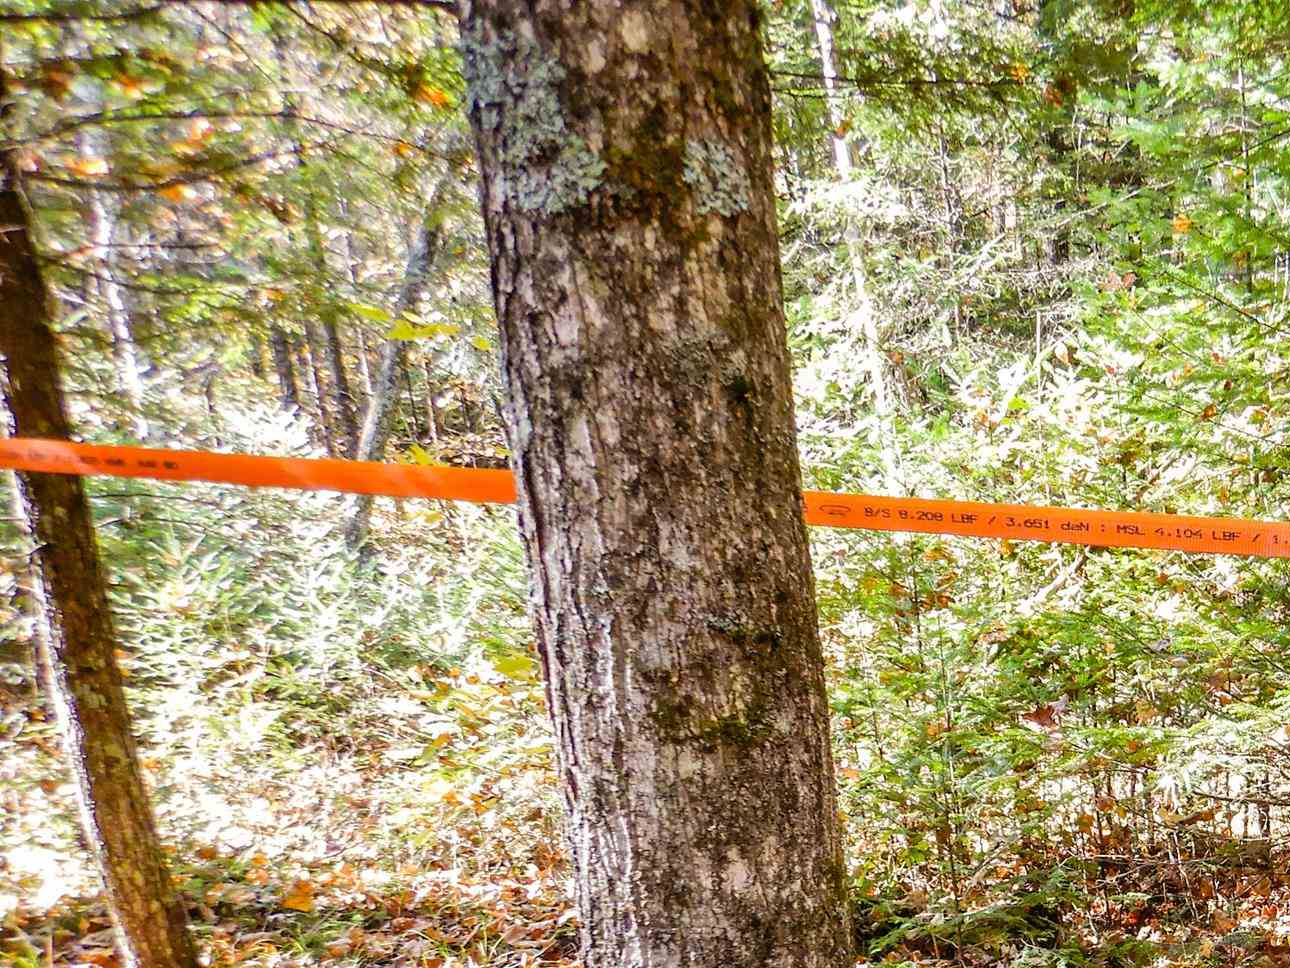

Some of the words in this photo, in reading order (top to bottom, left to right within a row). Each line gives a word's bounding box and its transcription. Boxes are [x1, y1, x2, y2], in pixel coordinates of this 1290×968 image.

[951, 513, 977, 524] LBF
[1116, 524, 1145, 536] MSL
[1155, 527, 1202, 539] 4.104
[1212, 531, 1240, 541] LBF
